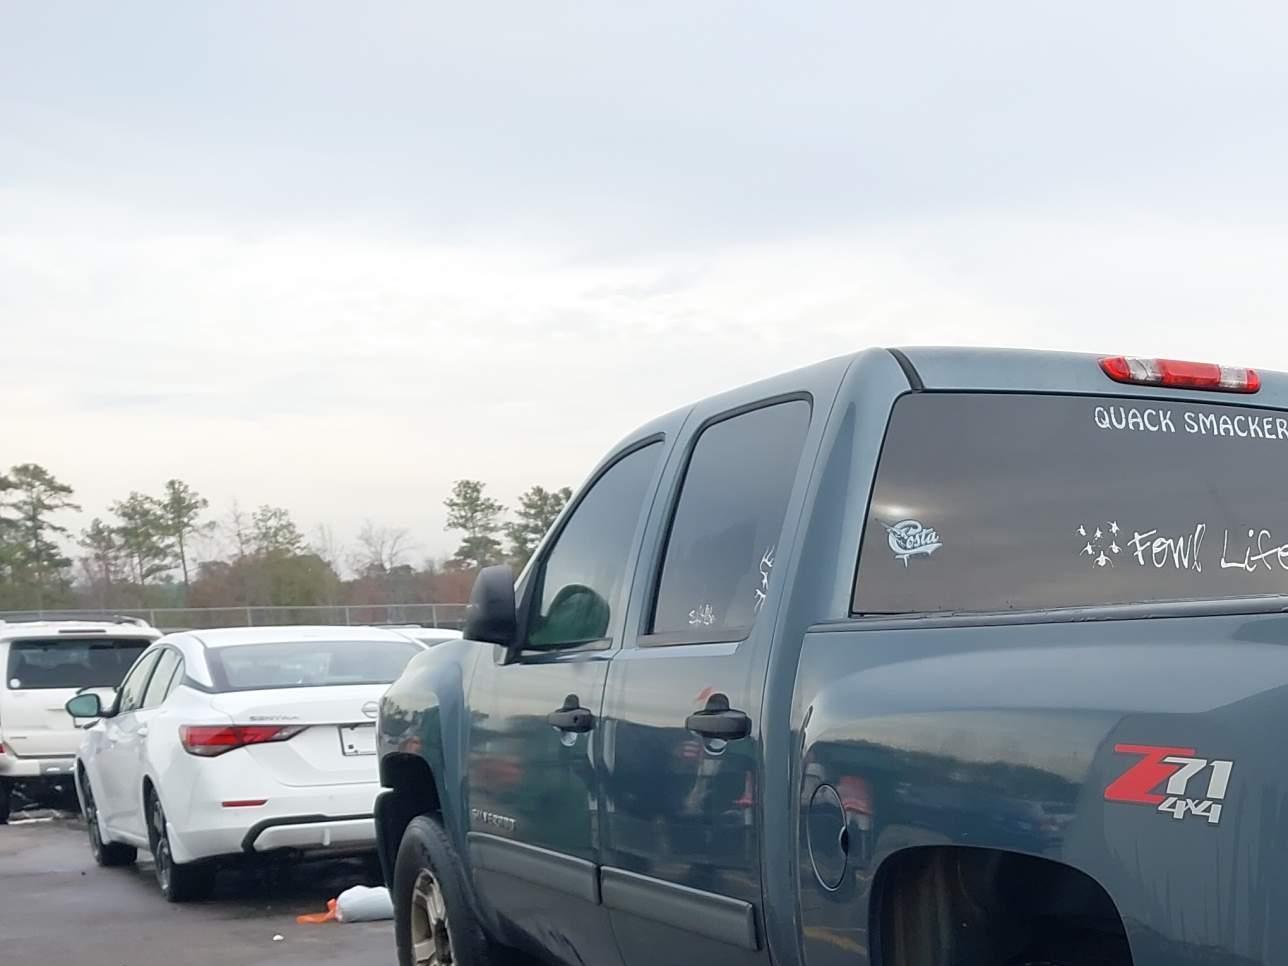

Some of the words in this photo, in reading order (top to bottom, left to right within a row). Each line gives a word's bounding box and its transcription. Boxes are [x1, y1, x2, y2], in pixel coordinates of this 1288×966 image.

[1094, 406, 1176, 433] QUACK
[887, 519, 943, 556] Costa
[1127, 523, 1206, 572] Fowl
[1104, 744, 1234, 804] Z71
